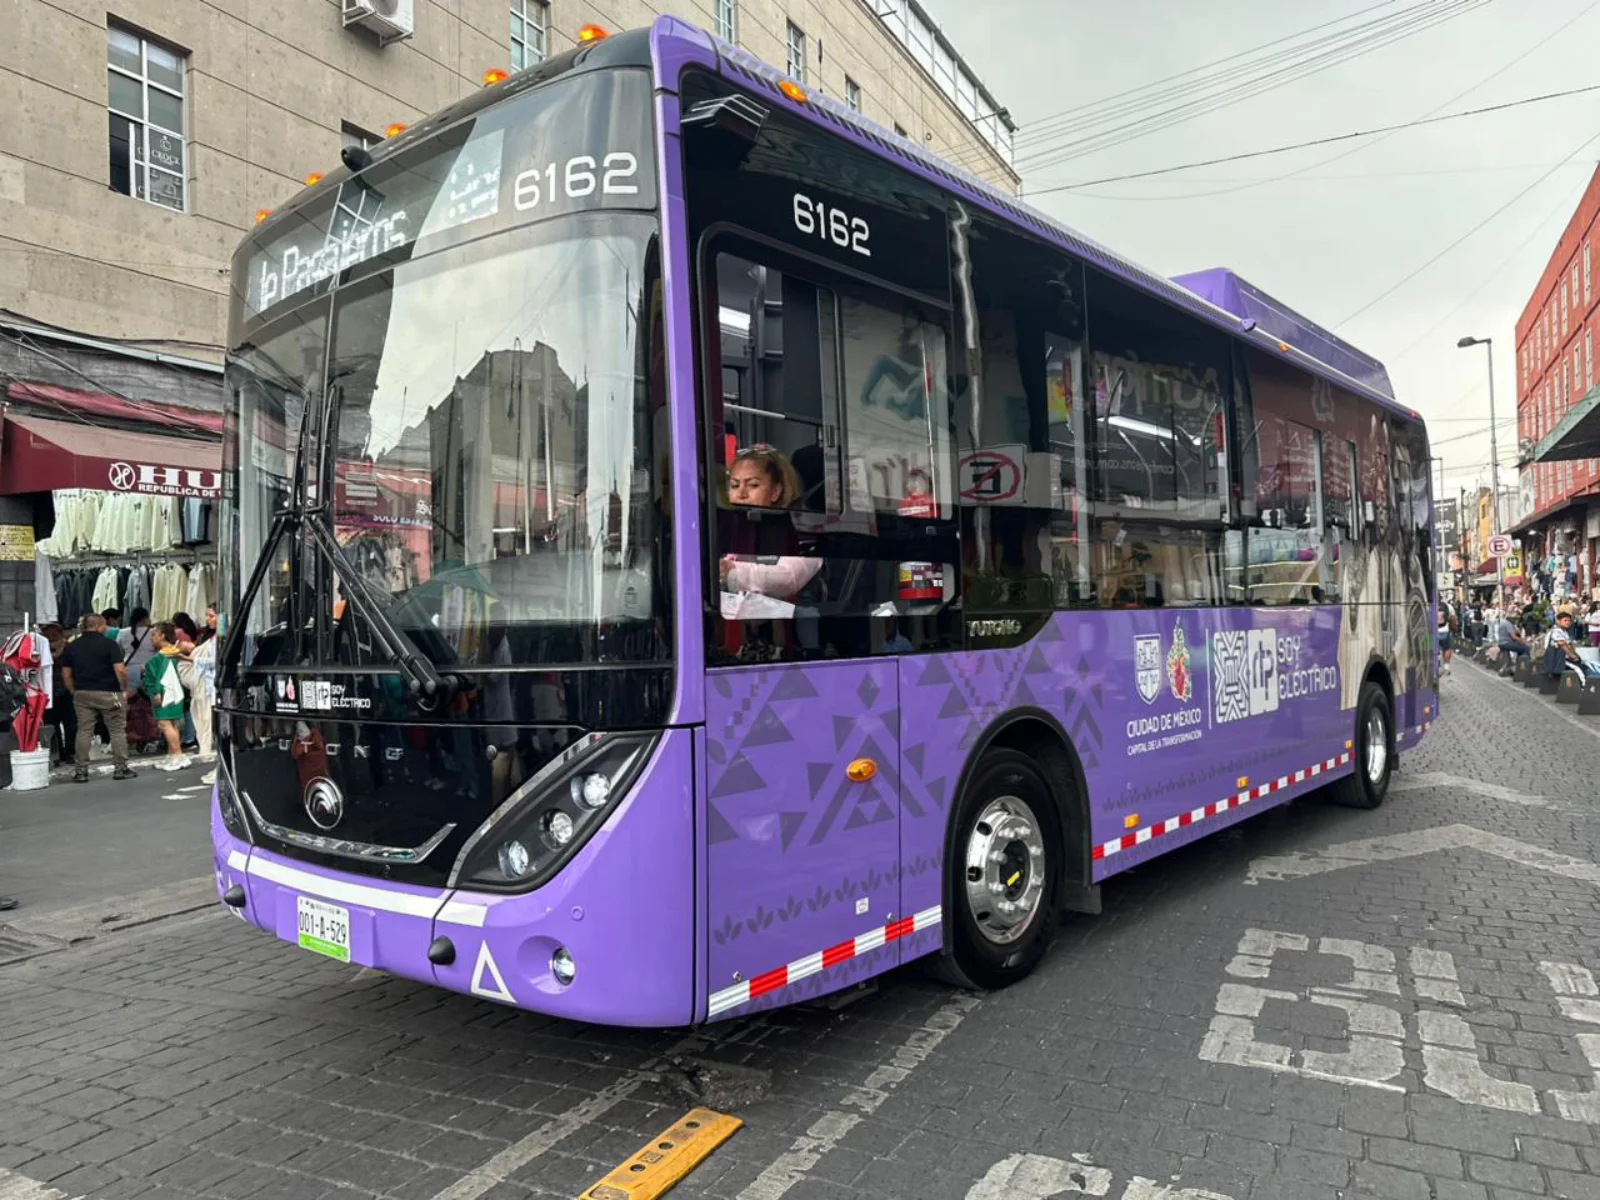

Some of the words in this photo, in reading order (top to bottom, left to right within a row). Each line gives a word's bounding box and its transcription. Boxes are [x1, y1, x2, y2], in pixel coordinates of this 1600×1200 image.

[514, 152, 638, 211] 6162
[793, 193, 871, 257] 6162
[138, 483, 199, 496] REPUBLICA
[202, 488, 215, 497] DE
[1494, 540, 1505, 552] E
[1278, 635, 1301, 663] SOY
[331, 684, 346, 695] SOY
[1126, 715, 1160, 738] CIUDAD
[1161, 713, 1172, 731] DE
[259, 736, 404, 761] YUTONG
[299, 911, 347, 945] 001-A-529
